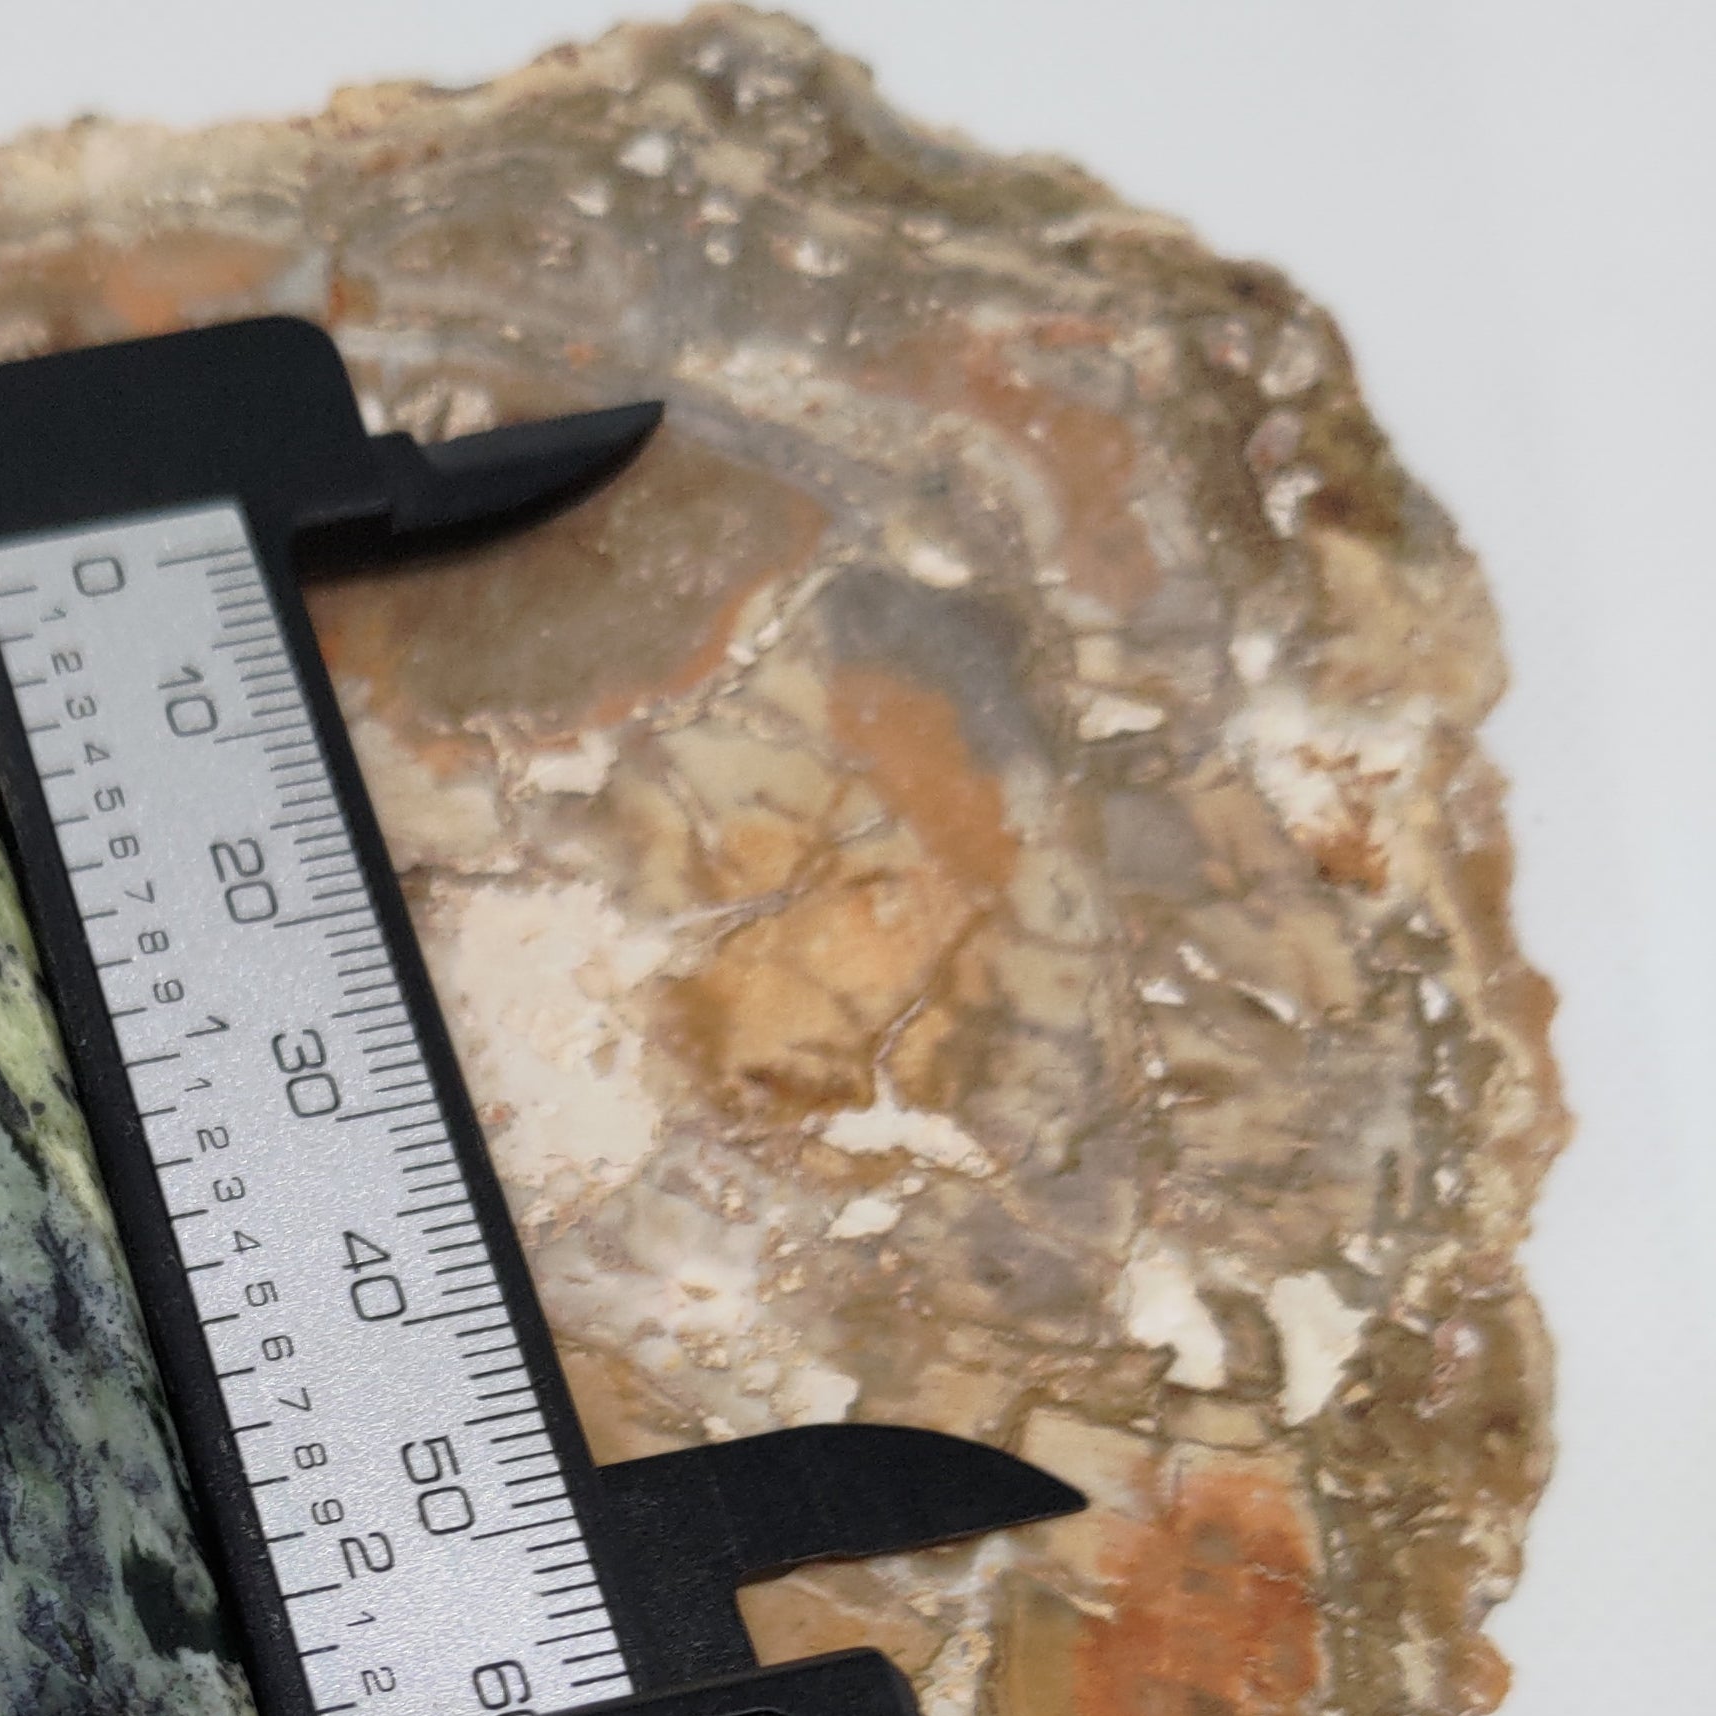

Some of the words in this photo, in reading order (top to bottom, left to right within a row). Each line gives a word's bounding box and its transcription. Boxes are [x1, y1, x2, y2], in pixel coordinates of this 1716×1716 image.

[71, 555, 127, 598] 0
[39, 606, 68, 623] 1
[50, 650, 84, 676] 2
[65, 695, 98, 720] 3
[157, 664, 220, 738] 10
[84, 741, 112, 767] 4
[92, 784, 126, 813] 5
[108, 834, 141, 861] 6
[124, 880, 156, 905] 7
[209, 836, 280, 924] 20
[137, 929, 171, 956] 8
[152, 978, 185, 1005] 9
[184, 1014, 231, 1039] 1
[183, 1076, 213, 1093] 1
[271, 1028, 342, 1119] 30
[196, 1125, 230, 1153] 2
[212, 1175, 246, 1203] 3
[232, 1230, 262, 1255] 4
[341, 1230, 408, 1323] 40
[244, 1279, 279, 1308] 5
[260, 1334, 295, 1362] 6
[278, 1386, 313, 1413] 7
[293, 1442, 327, 1470] 8
[400, 1434, 477, 1536] 50
[310, 1497, 345, 1526] 9
[339, 1531, 396, 1580] 2
[345, 1609, 378, 1628] 1
[360, 1665, 398, 1697] 2
